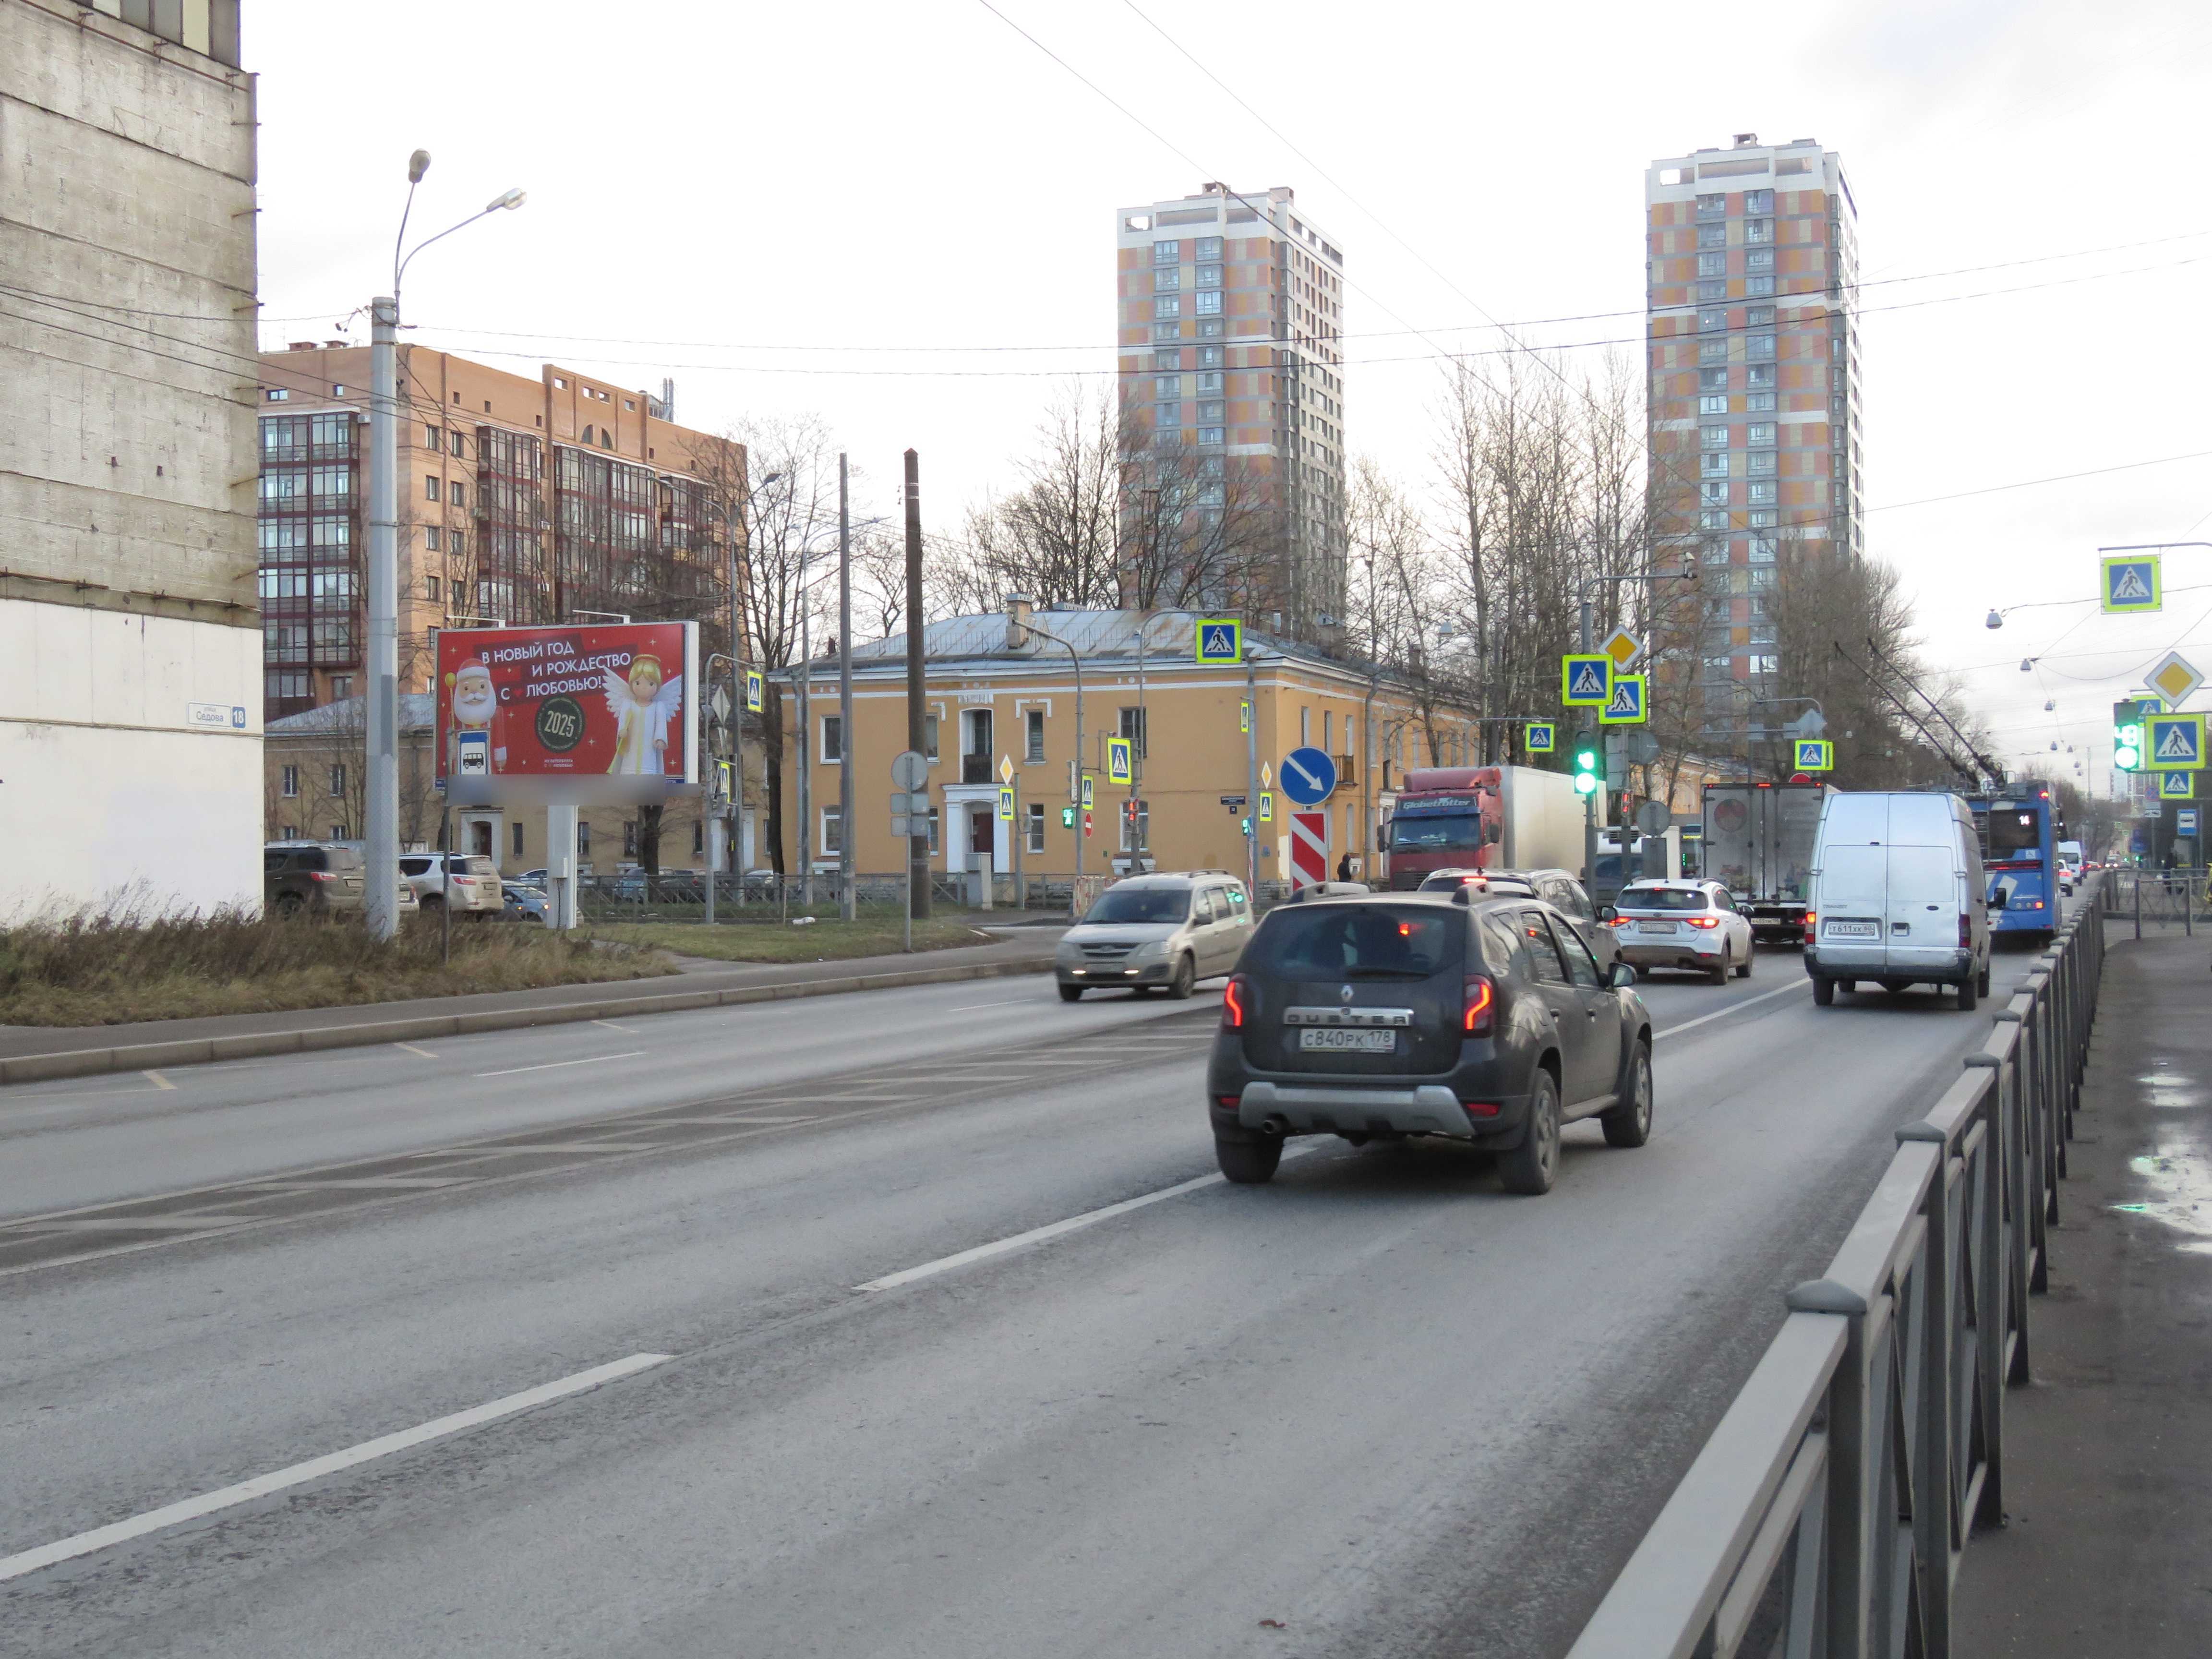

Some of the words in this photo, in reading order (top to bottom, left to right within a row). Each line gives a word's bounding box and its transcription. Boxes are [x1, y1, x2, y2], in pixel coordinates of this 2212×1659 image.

[481, 652, 490, 664] В
[494, 642, 543, 662] НОВЫЙ
[547, 641, 574, 656] ГОД
[532, 664, 542, 677] И
[547, 653, 631, 675] РОЖДЕСТВО
[501, 688, 510, 700] С
[526, 676, 602, 697] ЛЮБОВЬЮ!
[196, 711, 223, 722] Седова
[233, 710, 244, 723] 18
[544, 710, 576, 737] 2025
[1403, 797, 1470, 809] Globetrotter
[1287, 1014, 1406, 1024] DUSTER
